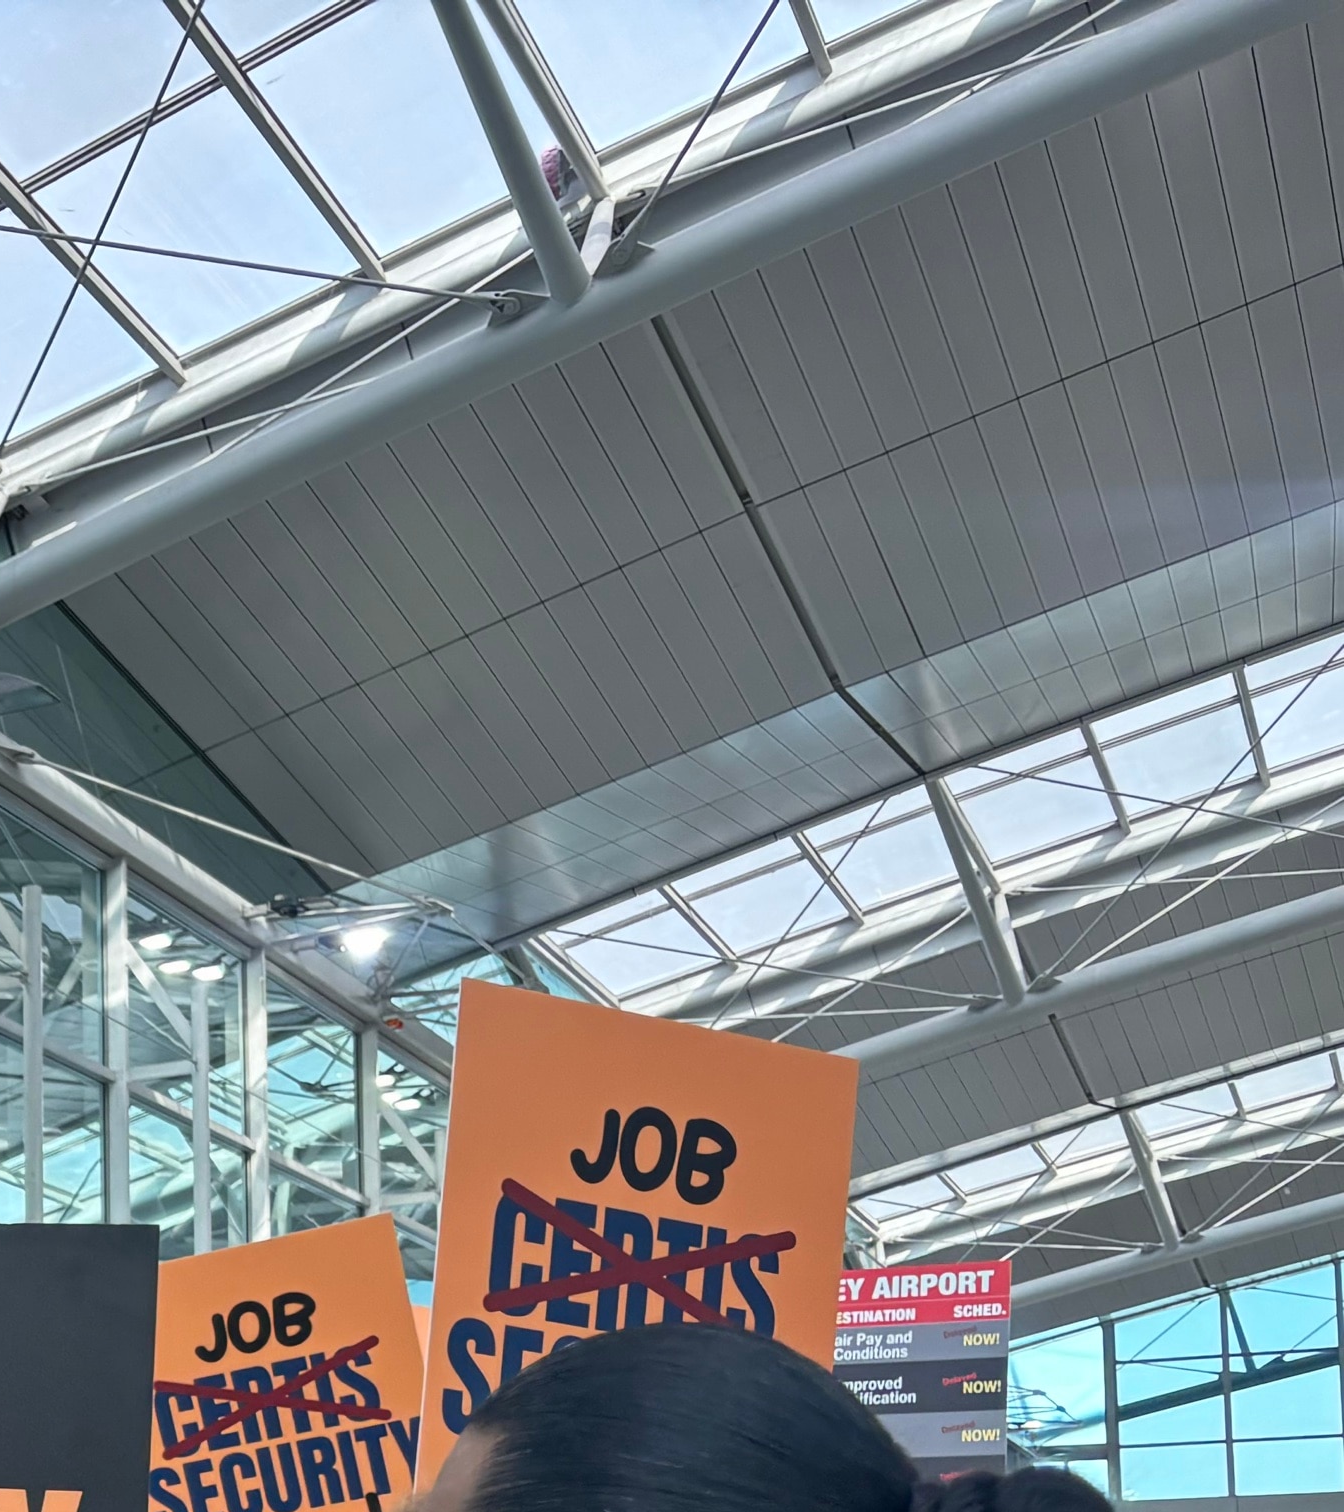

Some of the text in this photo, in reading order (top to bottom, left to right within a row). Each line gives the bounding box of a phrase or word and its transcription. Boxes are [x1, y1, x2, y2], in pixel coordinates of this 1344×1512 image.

[570, 1106, 738, 1205] JOB
[488, 1191, 780, 1340] CERTIS
[871, 1270, 995, 1299] AIRPORT
[953, 1303, 1006, 1318] SCHED.
[195, 1292, 316, 1363] JOB
[856, 1332, 883, 1349] Pay
[886, 1330, 913, 1344] and
[963, 1333, 1000, 1346] NOW!
[834, 1345, 908, 1361] Conditions
[962, 1380, 1001, 1394] NOW!
[155, 1346, 382, 1459] CERTIS
[961, 1428, 1000, 1442] NOW!
